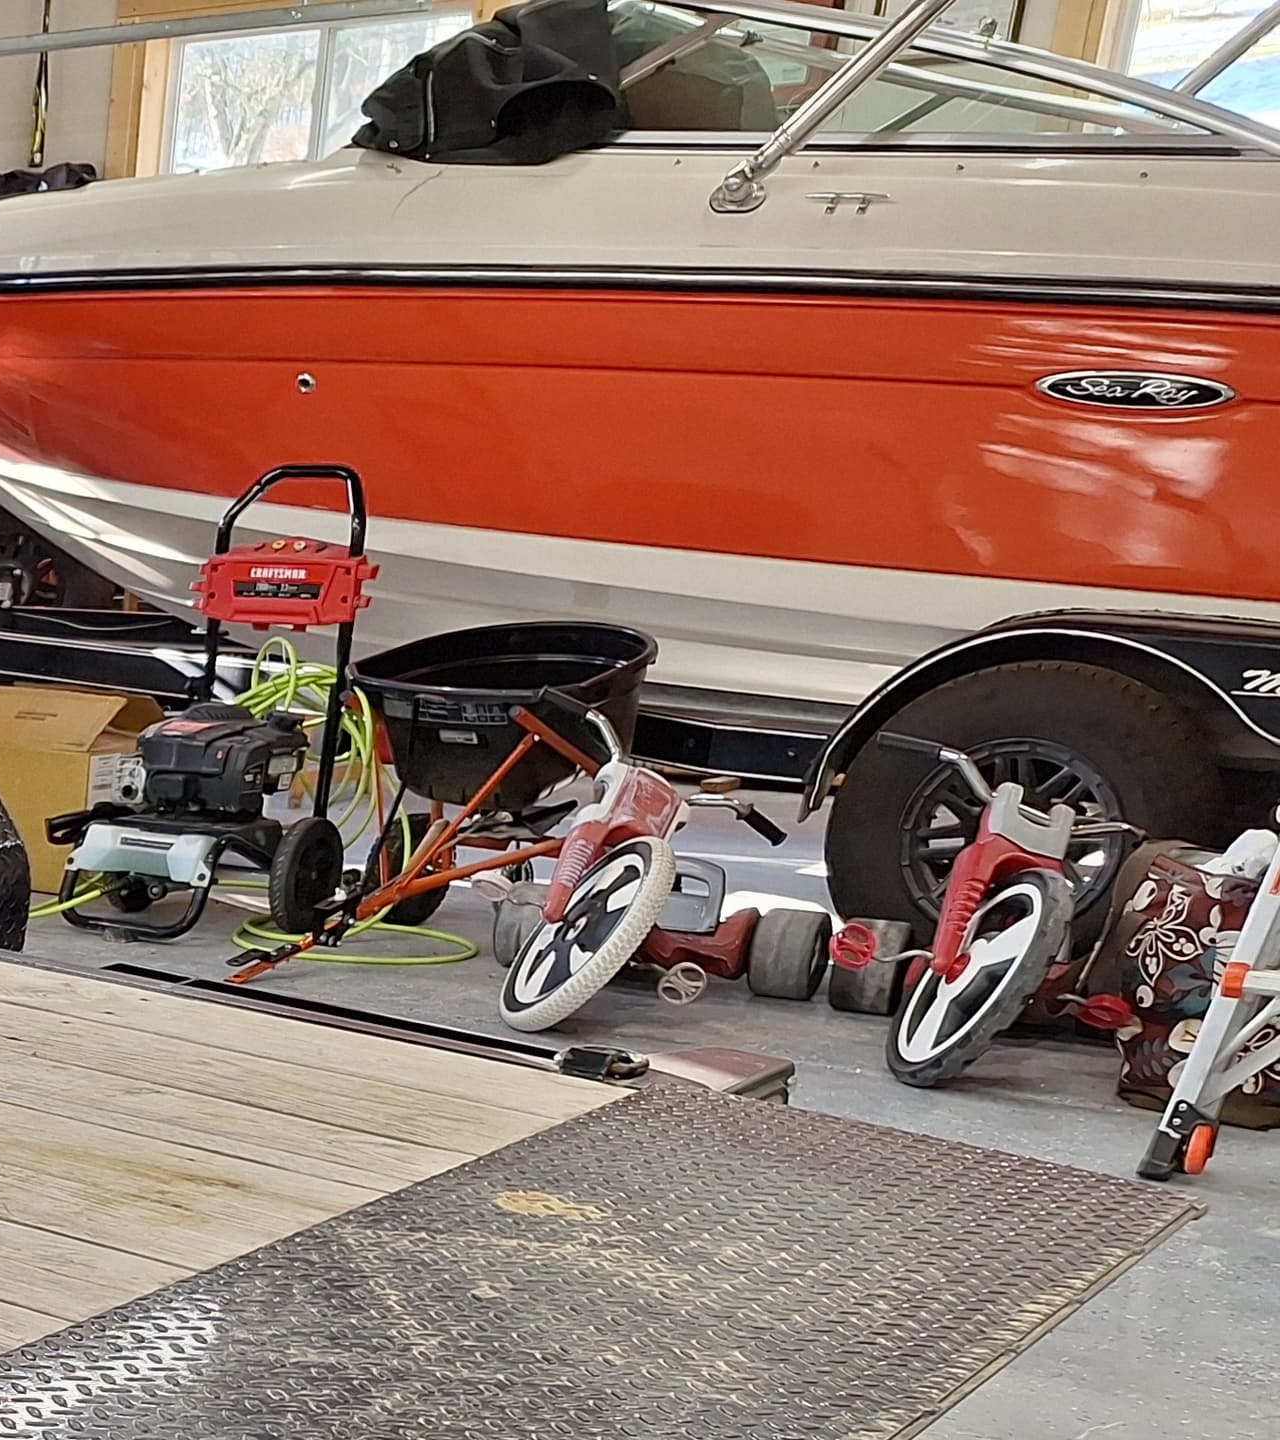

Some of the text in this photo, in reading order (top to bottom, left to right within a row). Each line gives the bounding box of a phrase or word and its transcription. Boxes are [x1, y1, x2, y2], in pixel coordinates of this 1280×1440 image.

[1065, 378, 1199, 405] Sea Ray
[250, 567, 307, 580] CRAFTSMAN
